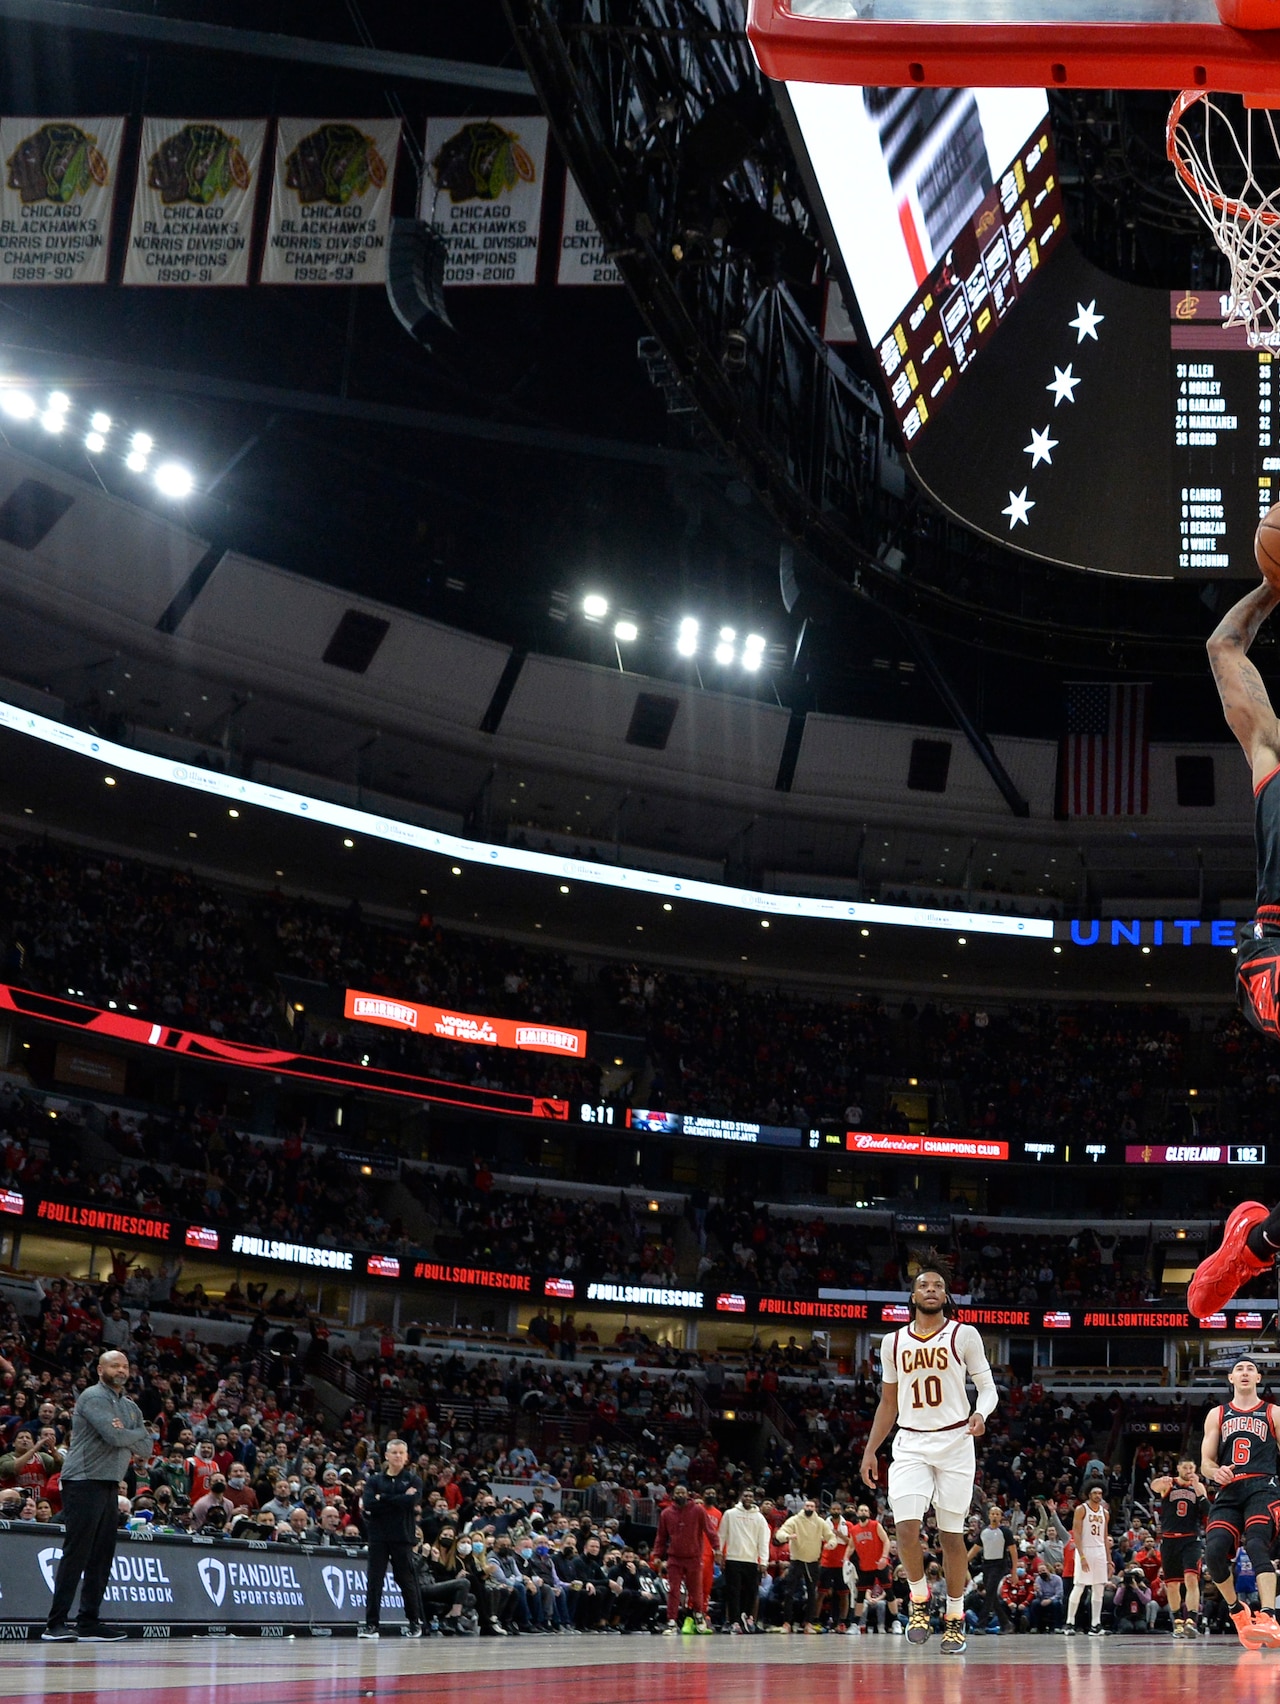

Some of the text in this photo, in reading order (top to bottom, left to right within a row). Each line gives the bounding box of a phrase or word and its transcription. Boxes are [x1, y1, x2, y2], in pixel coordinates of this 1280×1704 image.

[21, 205, 81, 218] CHICAGO
[163, 206, 224, 220] CHICAGO
[301, 206, 363, 219] CHICAGO
[450, 206, 511, 219] CHICAGO
[1, 219, 97, 233] BLACKHAWKS
[143, 221, 239, 235] BLACKHAWKS
[281, 219, 376, 234] BLACKHAWKS
[0, 235, 102, 248] ORRIS DIVISION
[132, 237, 245, 251] NORRIS DIVISION
[271, 236, 384, 249] NORRIS DIVISION
[483, 236, 536, 250] DIVISION
[3, 251, 85, 264] CHAMPIONS
[145, 253, 227, 267] CHAMPIONS
[285, 251, 366, 265] CHAMPIONS
[446, 253, 517, 265] HAMPIONS
[157, 268, 212, 281] 1990-91
[1188, 364, 1213, 378] ALLEN
[1180, 381, 1221, 395] 4 MOBLEY
[1188, 398, 1226, 412] GARLAND
[1175, 415, 1187, 429] 24
[1188, 416, 1238, 430] MARKKANEN
[1188, 432, 1218, 446] OKORO
[1189, 488, 1221, 502] CARUSO
[1259, 489, 1271, 503] 22
[1189, 504, 1224, 518] VUCEVIC
[1179, 521, 1226, 535] 11 DEROZAN
[1190, 538, 1217, 551] WHITE
[1179, 554, 1229, 568] 12 DOSUNMU
[1070, 920, 1237, 947] UNITE
[357, 1001, 413, 1022] SMIRNOFF
[441, 1015, 478, 1031] VODKA
[434, 1024, 498, 1043] THE PEOPLE
[518, 1030, 576, 1049] SMIRNOFF
[683, 1115, 695, 1127] ST.
[695, 1117, 721, 1130] JOHN'S
[721, 1119, 735, 1131] RED
[735, 1121, 760, 1134] STORM
[683, 1125, 757, 1142] CREIGHTON BLUEJAYS
[854, 1134, 1000, 1155] Budweiser CHAMPIONS CLUB
[1025, 1143, 1055, 1153] TIMEOUTS
[1086, 1144, 1106, 1154] FOULS
[1165, 1146, 1221, 1161] CLEVELAND
[37, 1200, 172, 1240] #BULLSONTHESCORE
[232, 1235, 354, 1271] #BULLSONTHESCORE
[414, 1262, 531, 1292] #BULLSONTHESCORE
[587, 1283, 704, 1309] #BULLSONTHESCORE
[759, 1298, 868, 1320] #BULLSONTHESCORE
[1084, 1312, 1190, 1328] #BULLSONTHESCORE
[901, 1346, 949, 1375] CAVS
[911, 1375, 943, 1410] 10
[1222, 1416, 1269, 1443] CHICAGO
[1232, 1437, 1252, 1466] 6
[1177, 1501, 1188, 1517] 9
[1090, 1524, 1101, 1537] 31
[227, 1562, 301, 1589] FANDUEL
[233, 1590, 305, 1606] SPORTSBOOK
